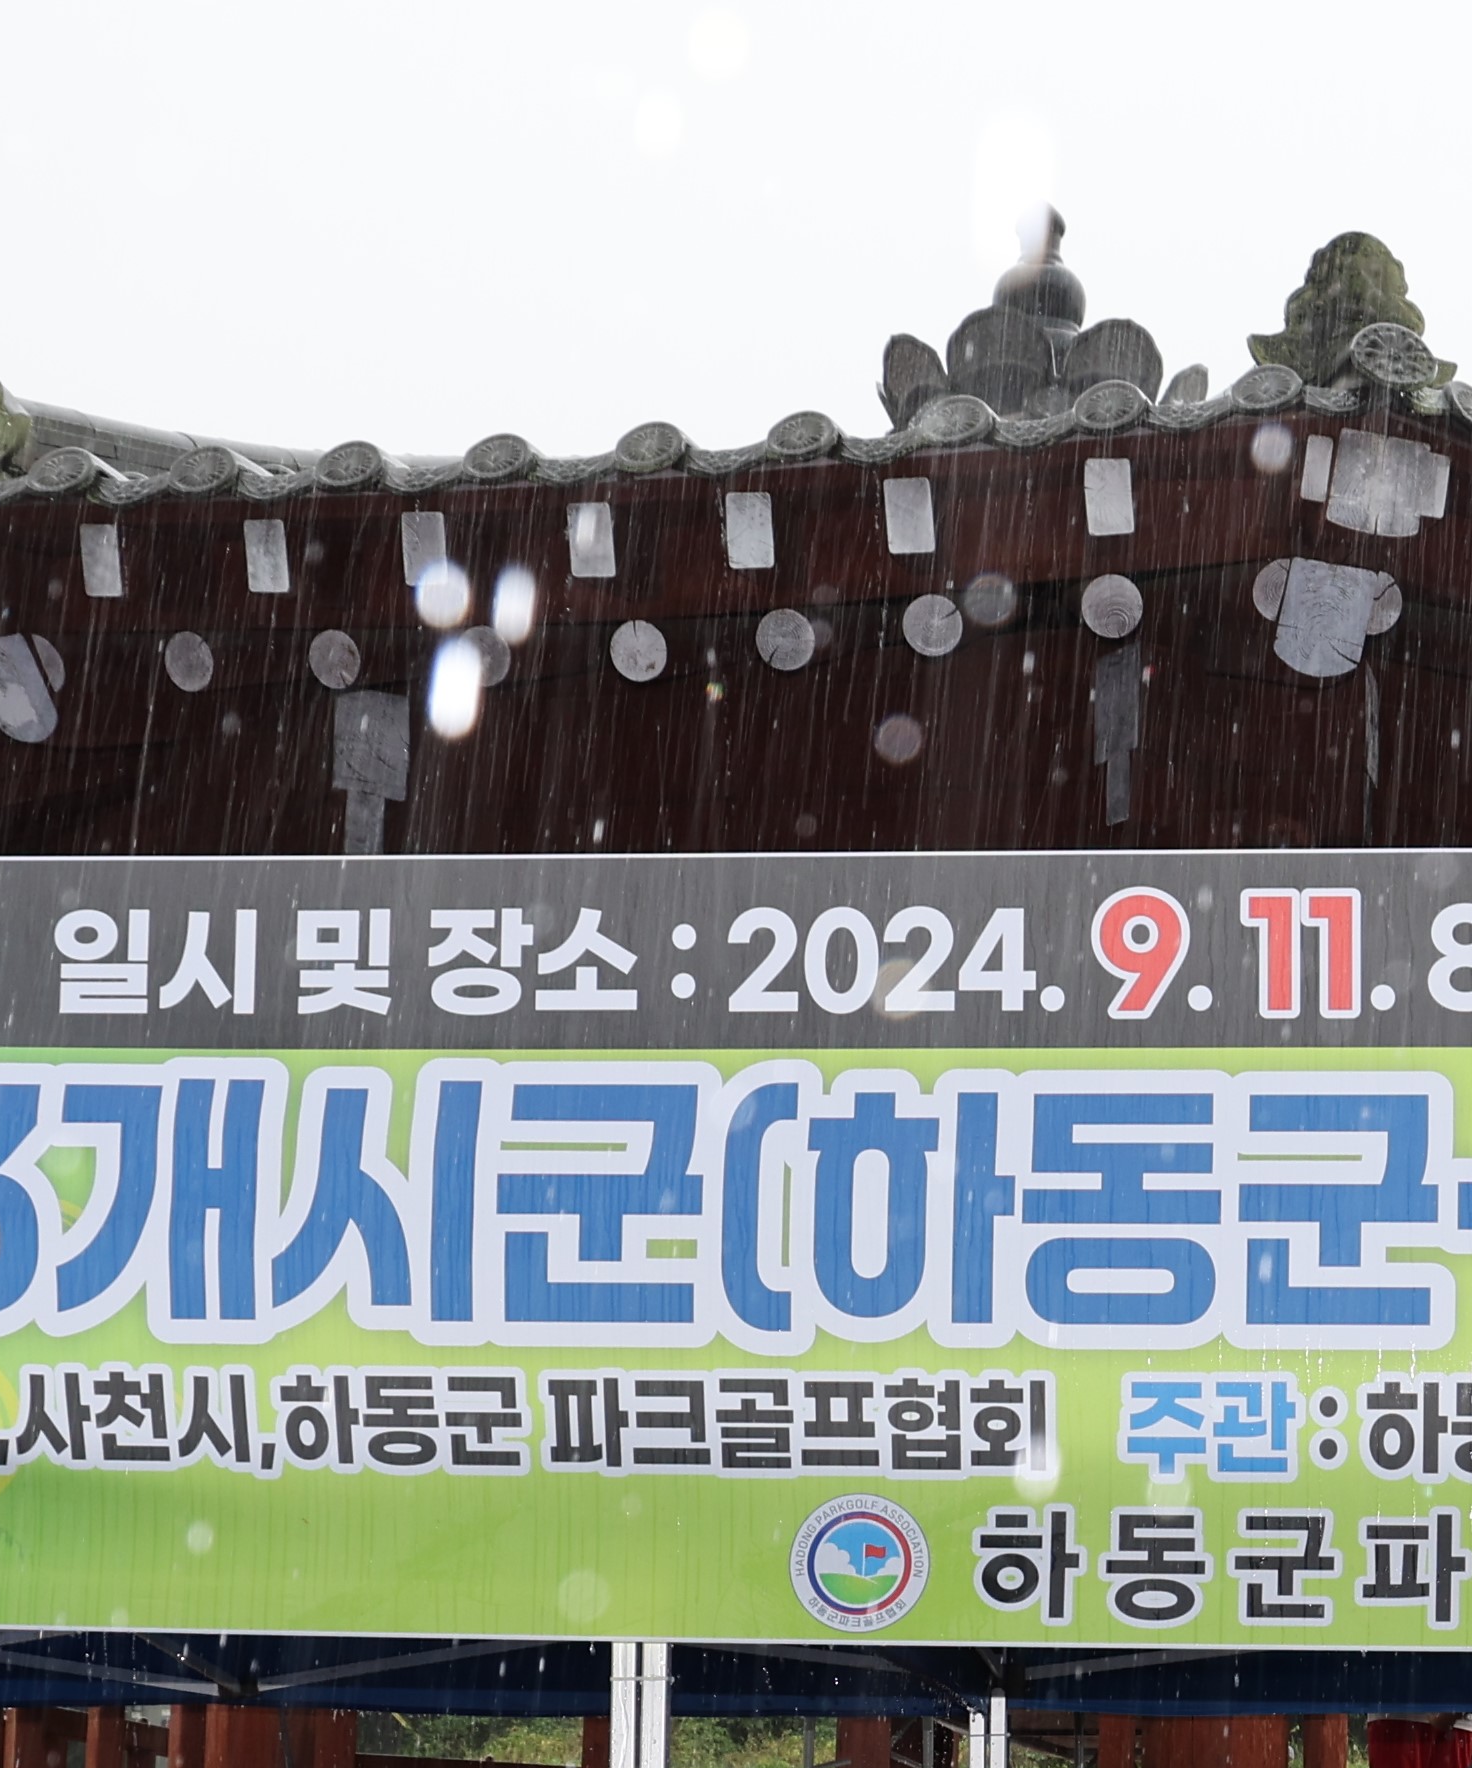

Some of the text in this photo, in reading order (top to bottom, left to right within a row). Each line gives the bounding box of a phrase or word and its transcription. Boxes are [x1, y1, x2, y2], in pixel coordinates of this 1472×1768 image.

[54, 908, 257, 1015] 일시
[295, 907, 396, 1016] 및
[428, 906, 639, 1016] 장소
[726, 905, 1066, 1014] 2024.
[1091, 887, 1214, 1020] 9.
[1239, 887, 1397, 1019] 11.
[548, 1378, 1050, 1472] 파크골프협회
[1127, 1381, 1297, 1475] 주관
[795, 1499, 925, 1578] HADONG PARKGOLF ASSOCIATION
